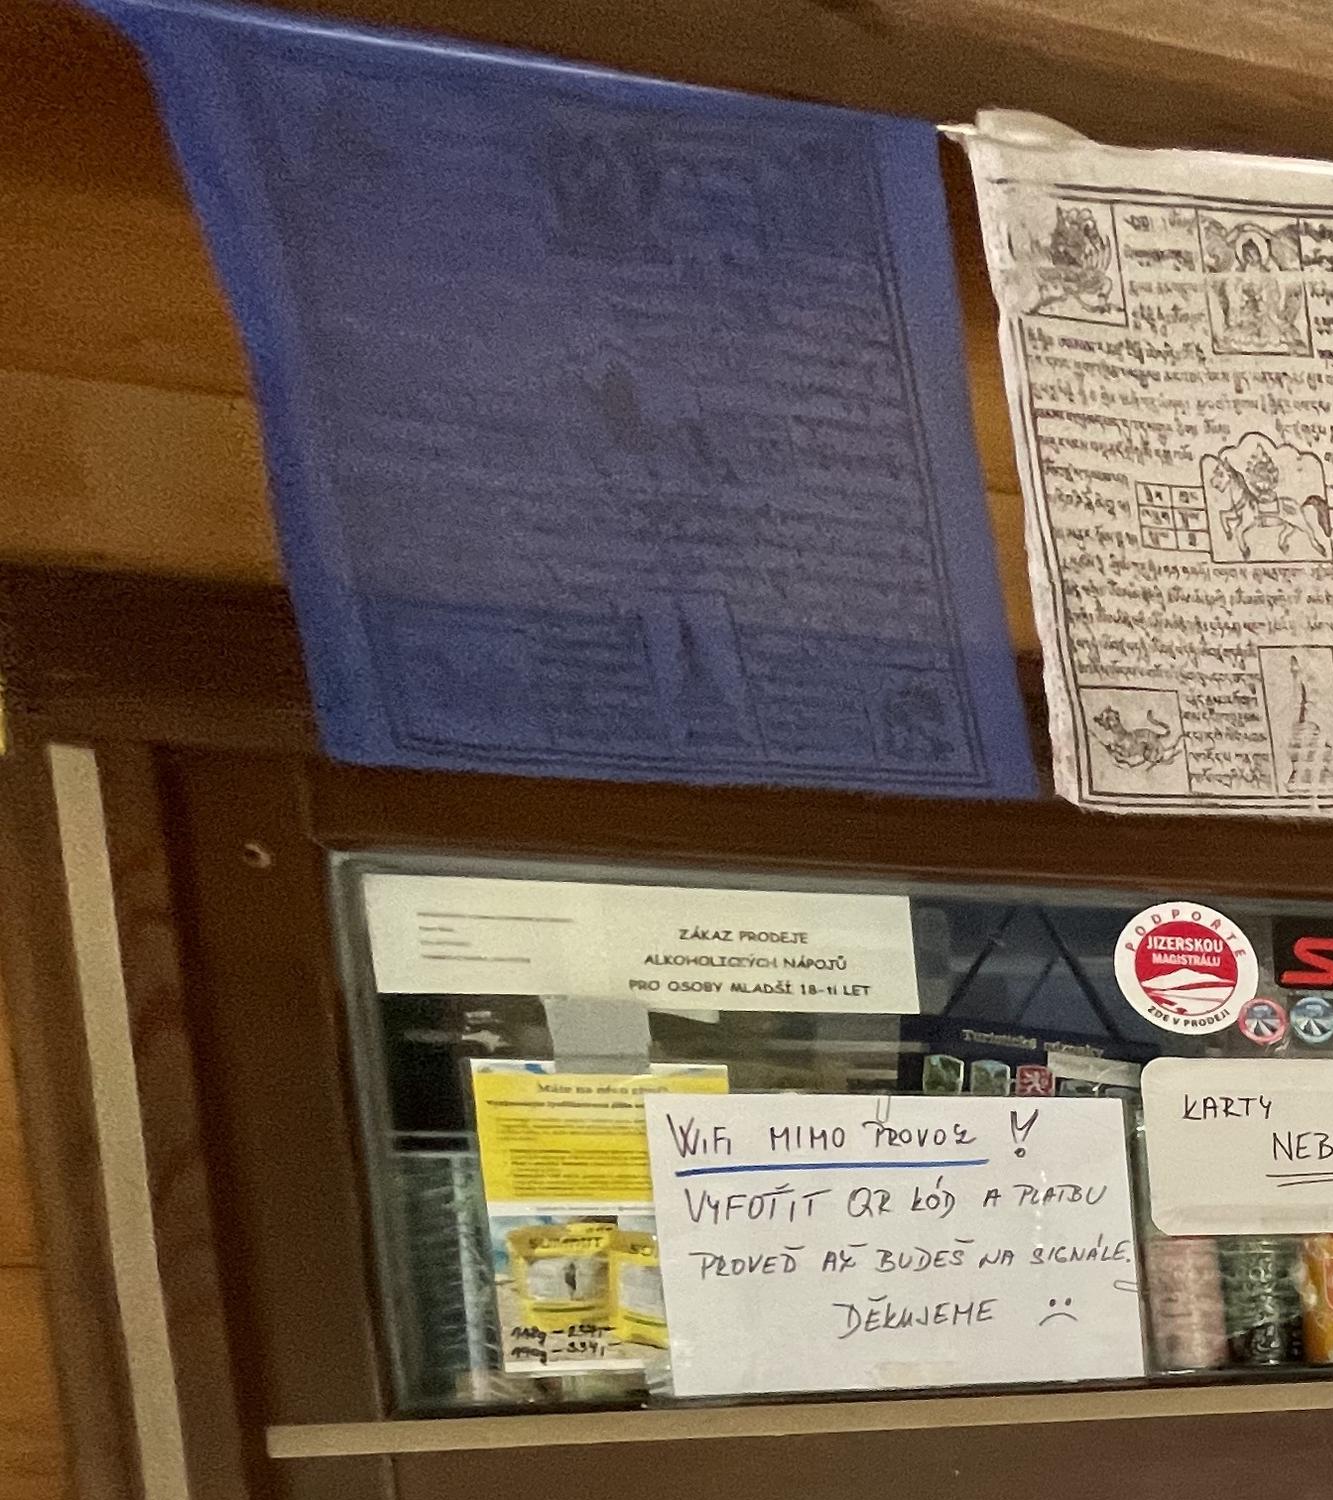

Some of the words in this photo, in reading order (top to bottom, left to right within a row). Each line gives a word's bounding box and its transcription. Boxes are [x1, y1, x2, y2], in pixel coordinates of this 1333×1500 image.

[678, 926, 733, 942] ZÁKAZ
[739, 931, 808, 944] PRODEJE
[1146, 935, 1224, 953] JIZERSKOU
[783, 955, 848, 971] NÁPOJŮ
[1152, 952, 1221, 967] MAGISTRÁLU
[629, 979, 660, 991] PRO
[668, 981, 723, 992] OSOBY
[843, 985, 871, 996] LET
[1184, 1093, 1273, 1122] KARTY
[770, 1125, 845, 1152] MIMO
[863, 1121, 977, 1148] PROVOZ
[847, 1187, 895, 1218] QR
[911, 1175, 956, 1219] KÓD
[983, 1190, 1001, 1207] A
[1013, 1184, 1107, 1207] PLATBU
[875, 1239, 975, 1272] BUDEŠ
[978, 1250, 1014, 1269] NA
[833, 1295, 999, 1339] DĚKUJEME
